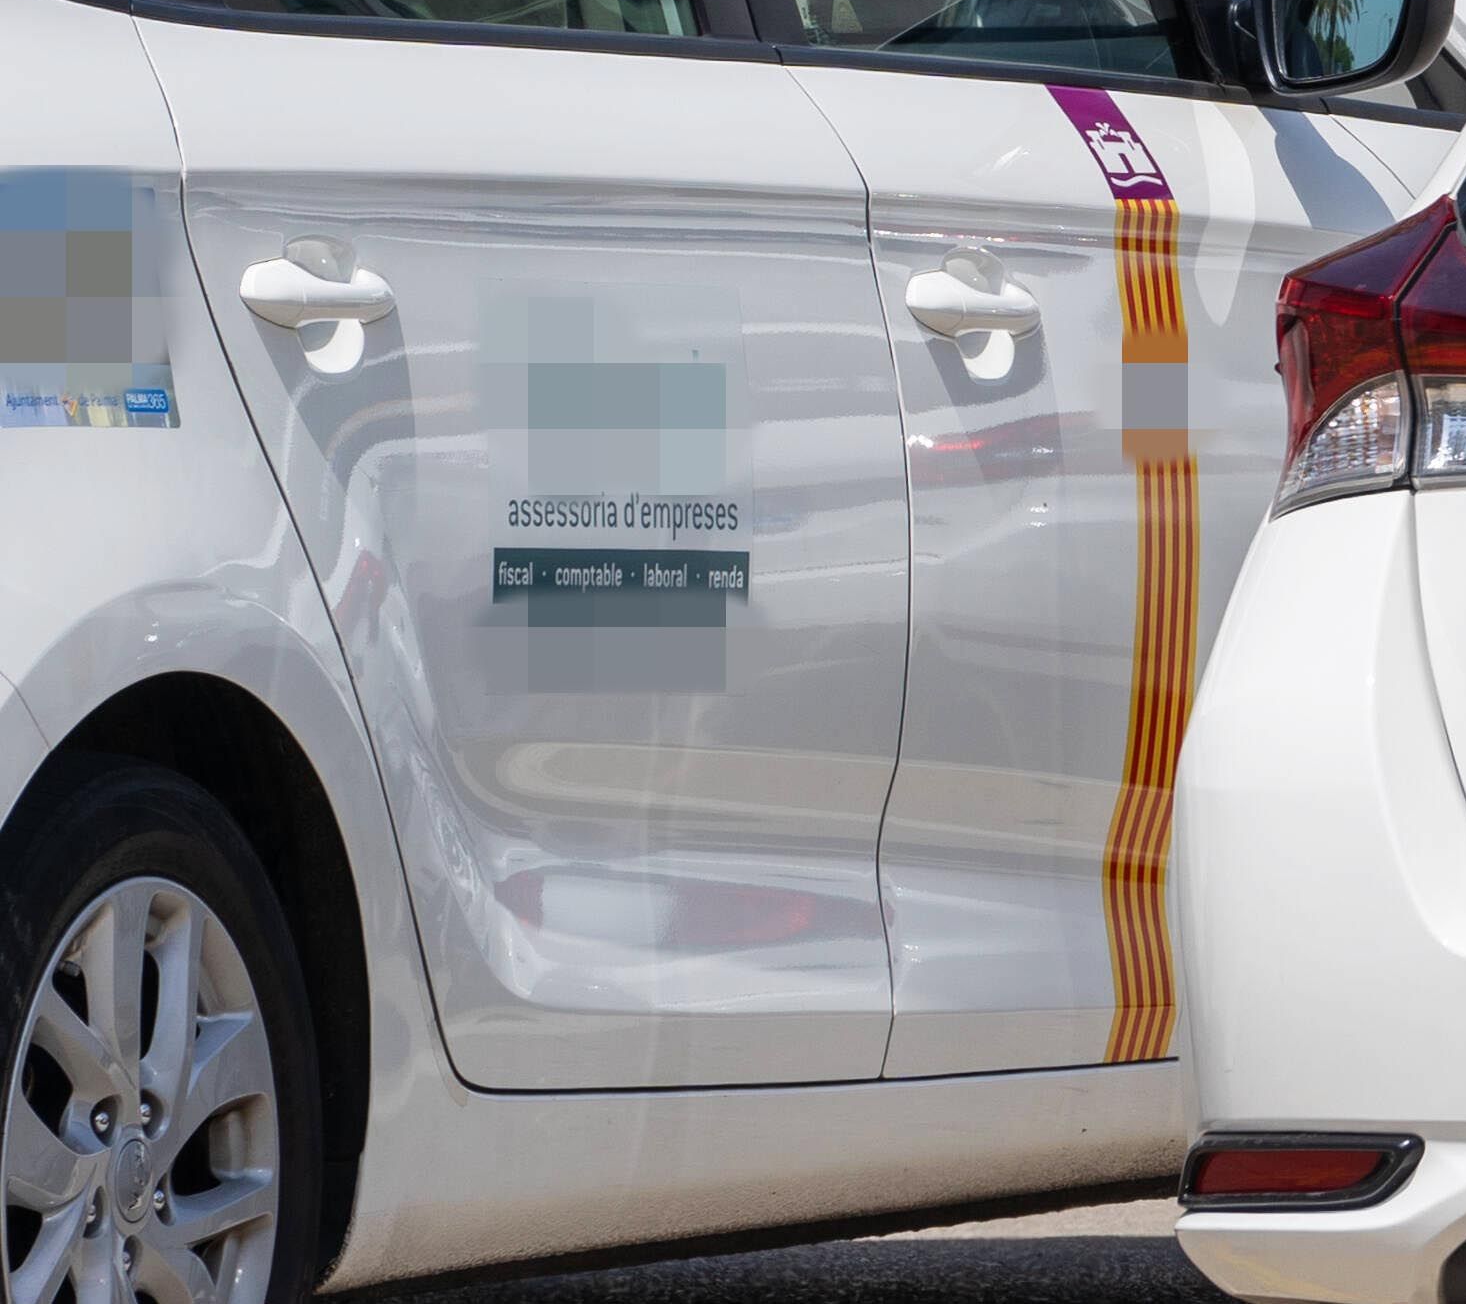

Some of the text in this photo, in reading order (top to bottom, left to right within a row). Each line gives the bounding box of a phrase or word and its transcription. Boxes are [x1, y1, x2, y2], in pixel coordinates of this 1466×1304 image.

[508, 492, 739, 541] assessoria d'empreses
[498, 561, 744, 590] fiscal comptable laboral renda
